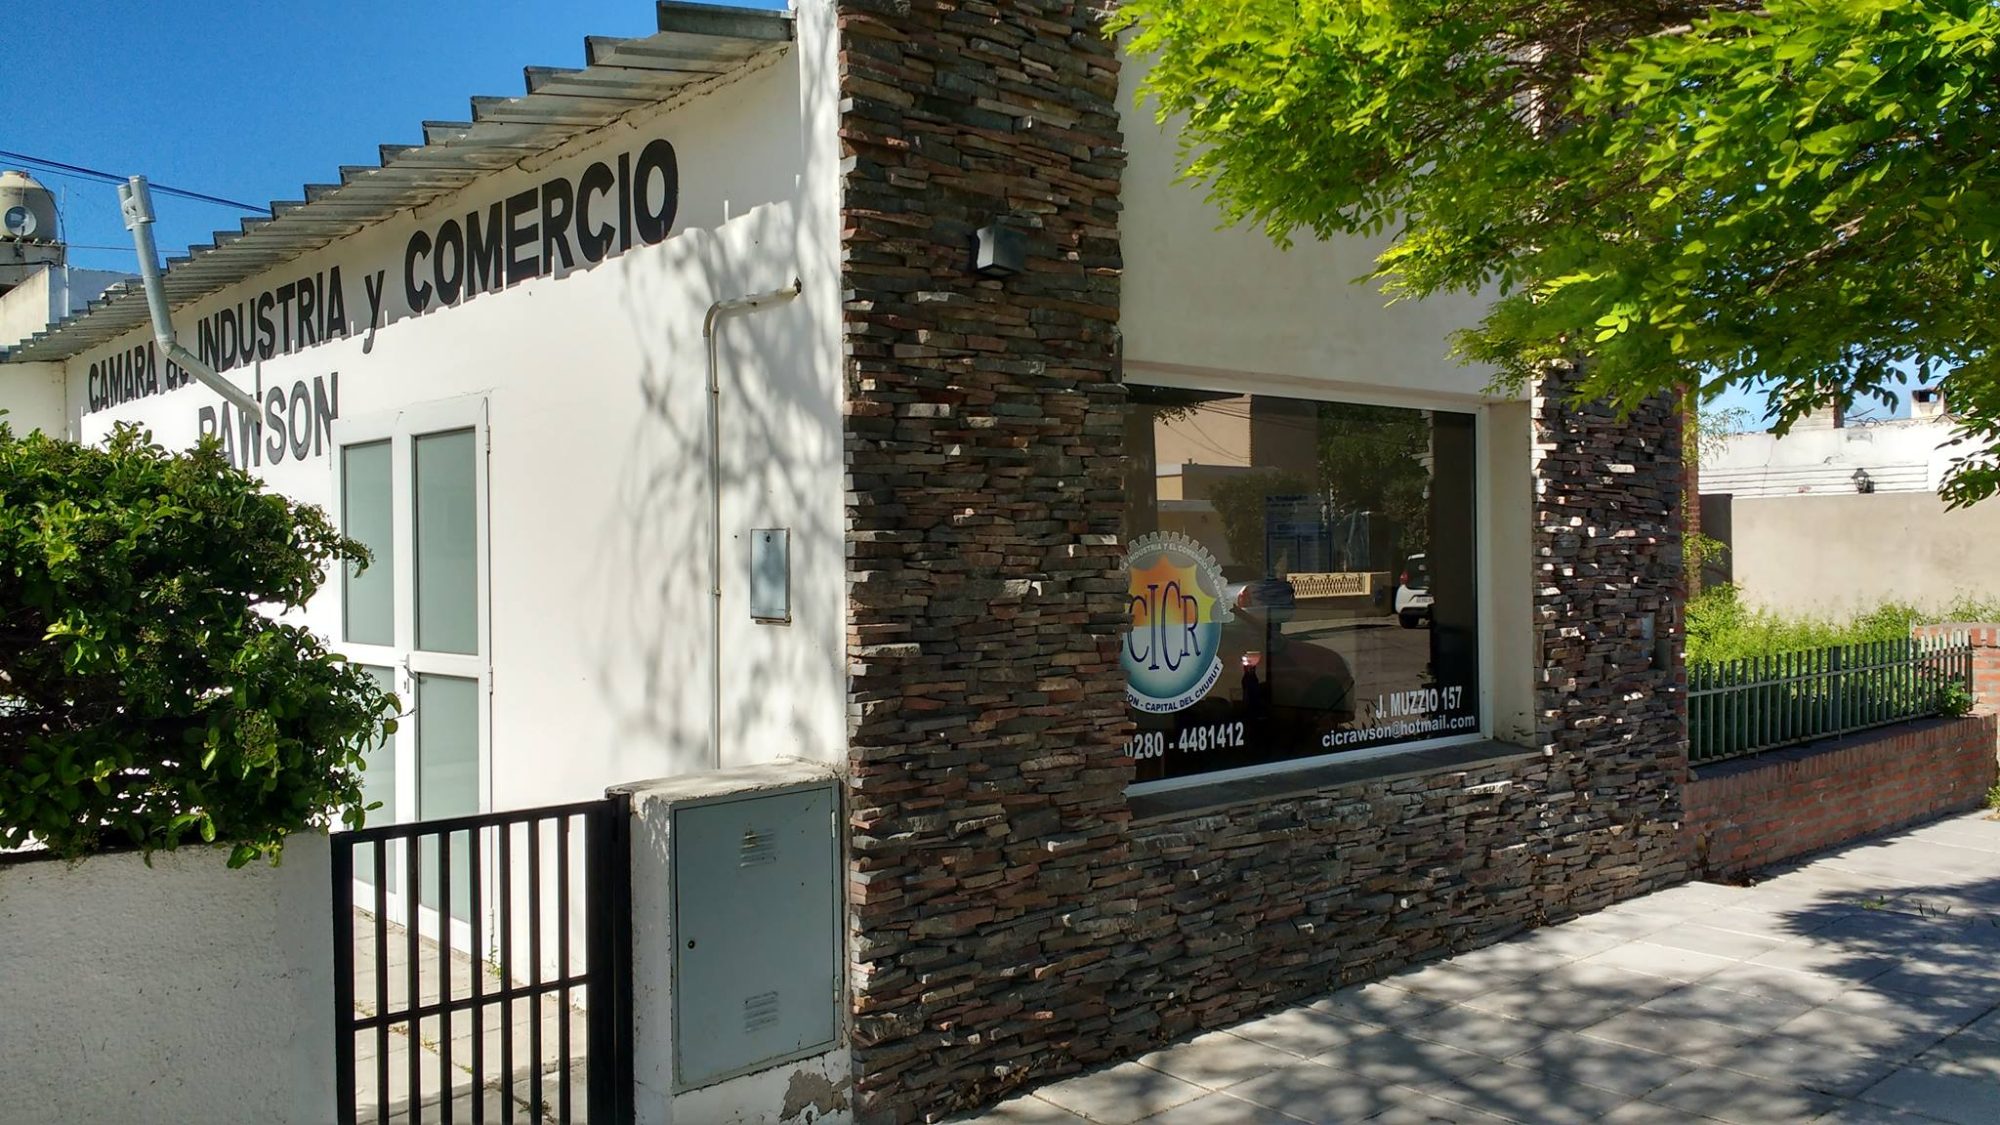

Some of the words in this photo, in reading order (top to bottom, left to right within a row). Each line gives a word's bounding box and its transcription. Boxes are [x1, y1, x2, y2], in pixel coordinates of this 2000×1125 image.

[89, 341, 158, 413] CAMARA
[198, 265, 347, 373] INDUSTRIA
[405, 138, 679, 313] COMERCIO
[1128, 543, 1161, 563] INDUSTRIA
[1169, 542, 1178, 551] EL
[1128, 580, 1200, 671] CICR
[1145, 702, 1178, 711] CAPITAL
[1180, 695, 1193, 708] DEL
[1195, 663, 1220, 697] CHUBUT
[1375, 694, 1387, 719] J.
[1390, 688, 1438, 718] MUZZIO
[1442, 685, 1462, 710] 157
[1179, 721, 1245, 753] 4481412
[1322, 714, 1475, 747] cicrawson@hotmail.com
